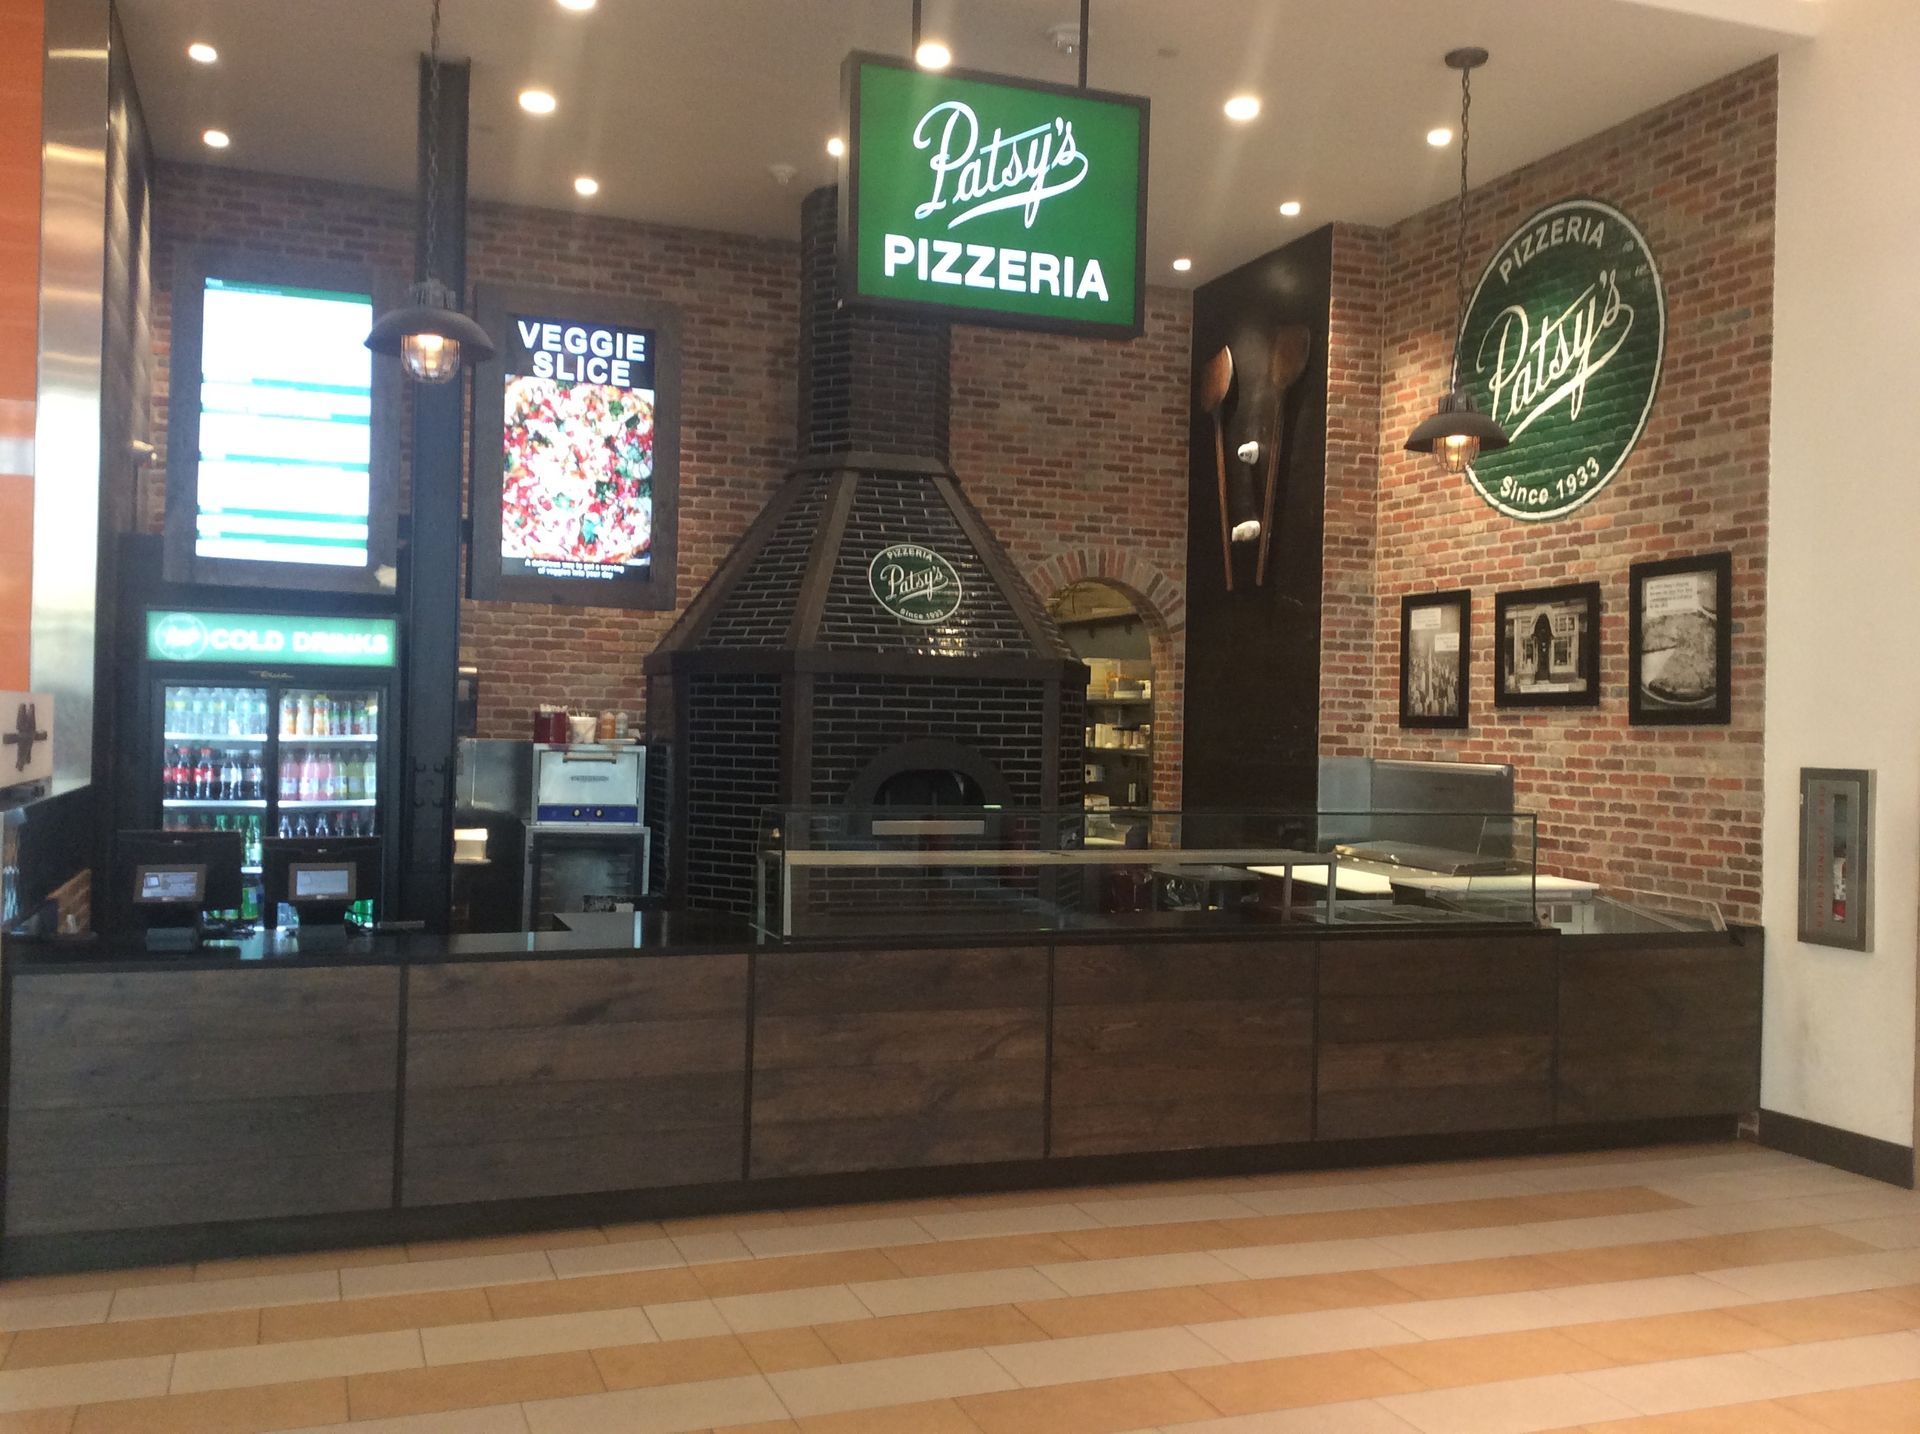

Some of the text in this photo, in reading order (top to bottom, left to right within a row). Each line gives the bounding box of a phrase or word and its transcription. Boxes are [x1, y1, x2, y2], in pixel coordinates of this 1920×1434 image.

[912, 101, 1089, 229] Patsy's
[884, 233, 1109, 302] PIZZERIA
[1499, 216, 1605, 284] PIZZERIA
[517, 320, 646, 362] VEGGIE
[1476, 269, 1634, 443] Patsy's
[532, 350, 631, 387] SLICE
[1500, 456, 1600, 504] Since 1933
[886, 548, 933, 562] PIZZERIA
[880, 564, 949, 603] Patsy's
[210, 628, 284, 650] COLD
[292, 631, 388, 655] DRINKS
